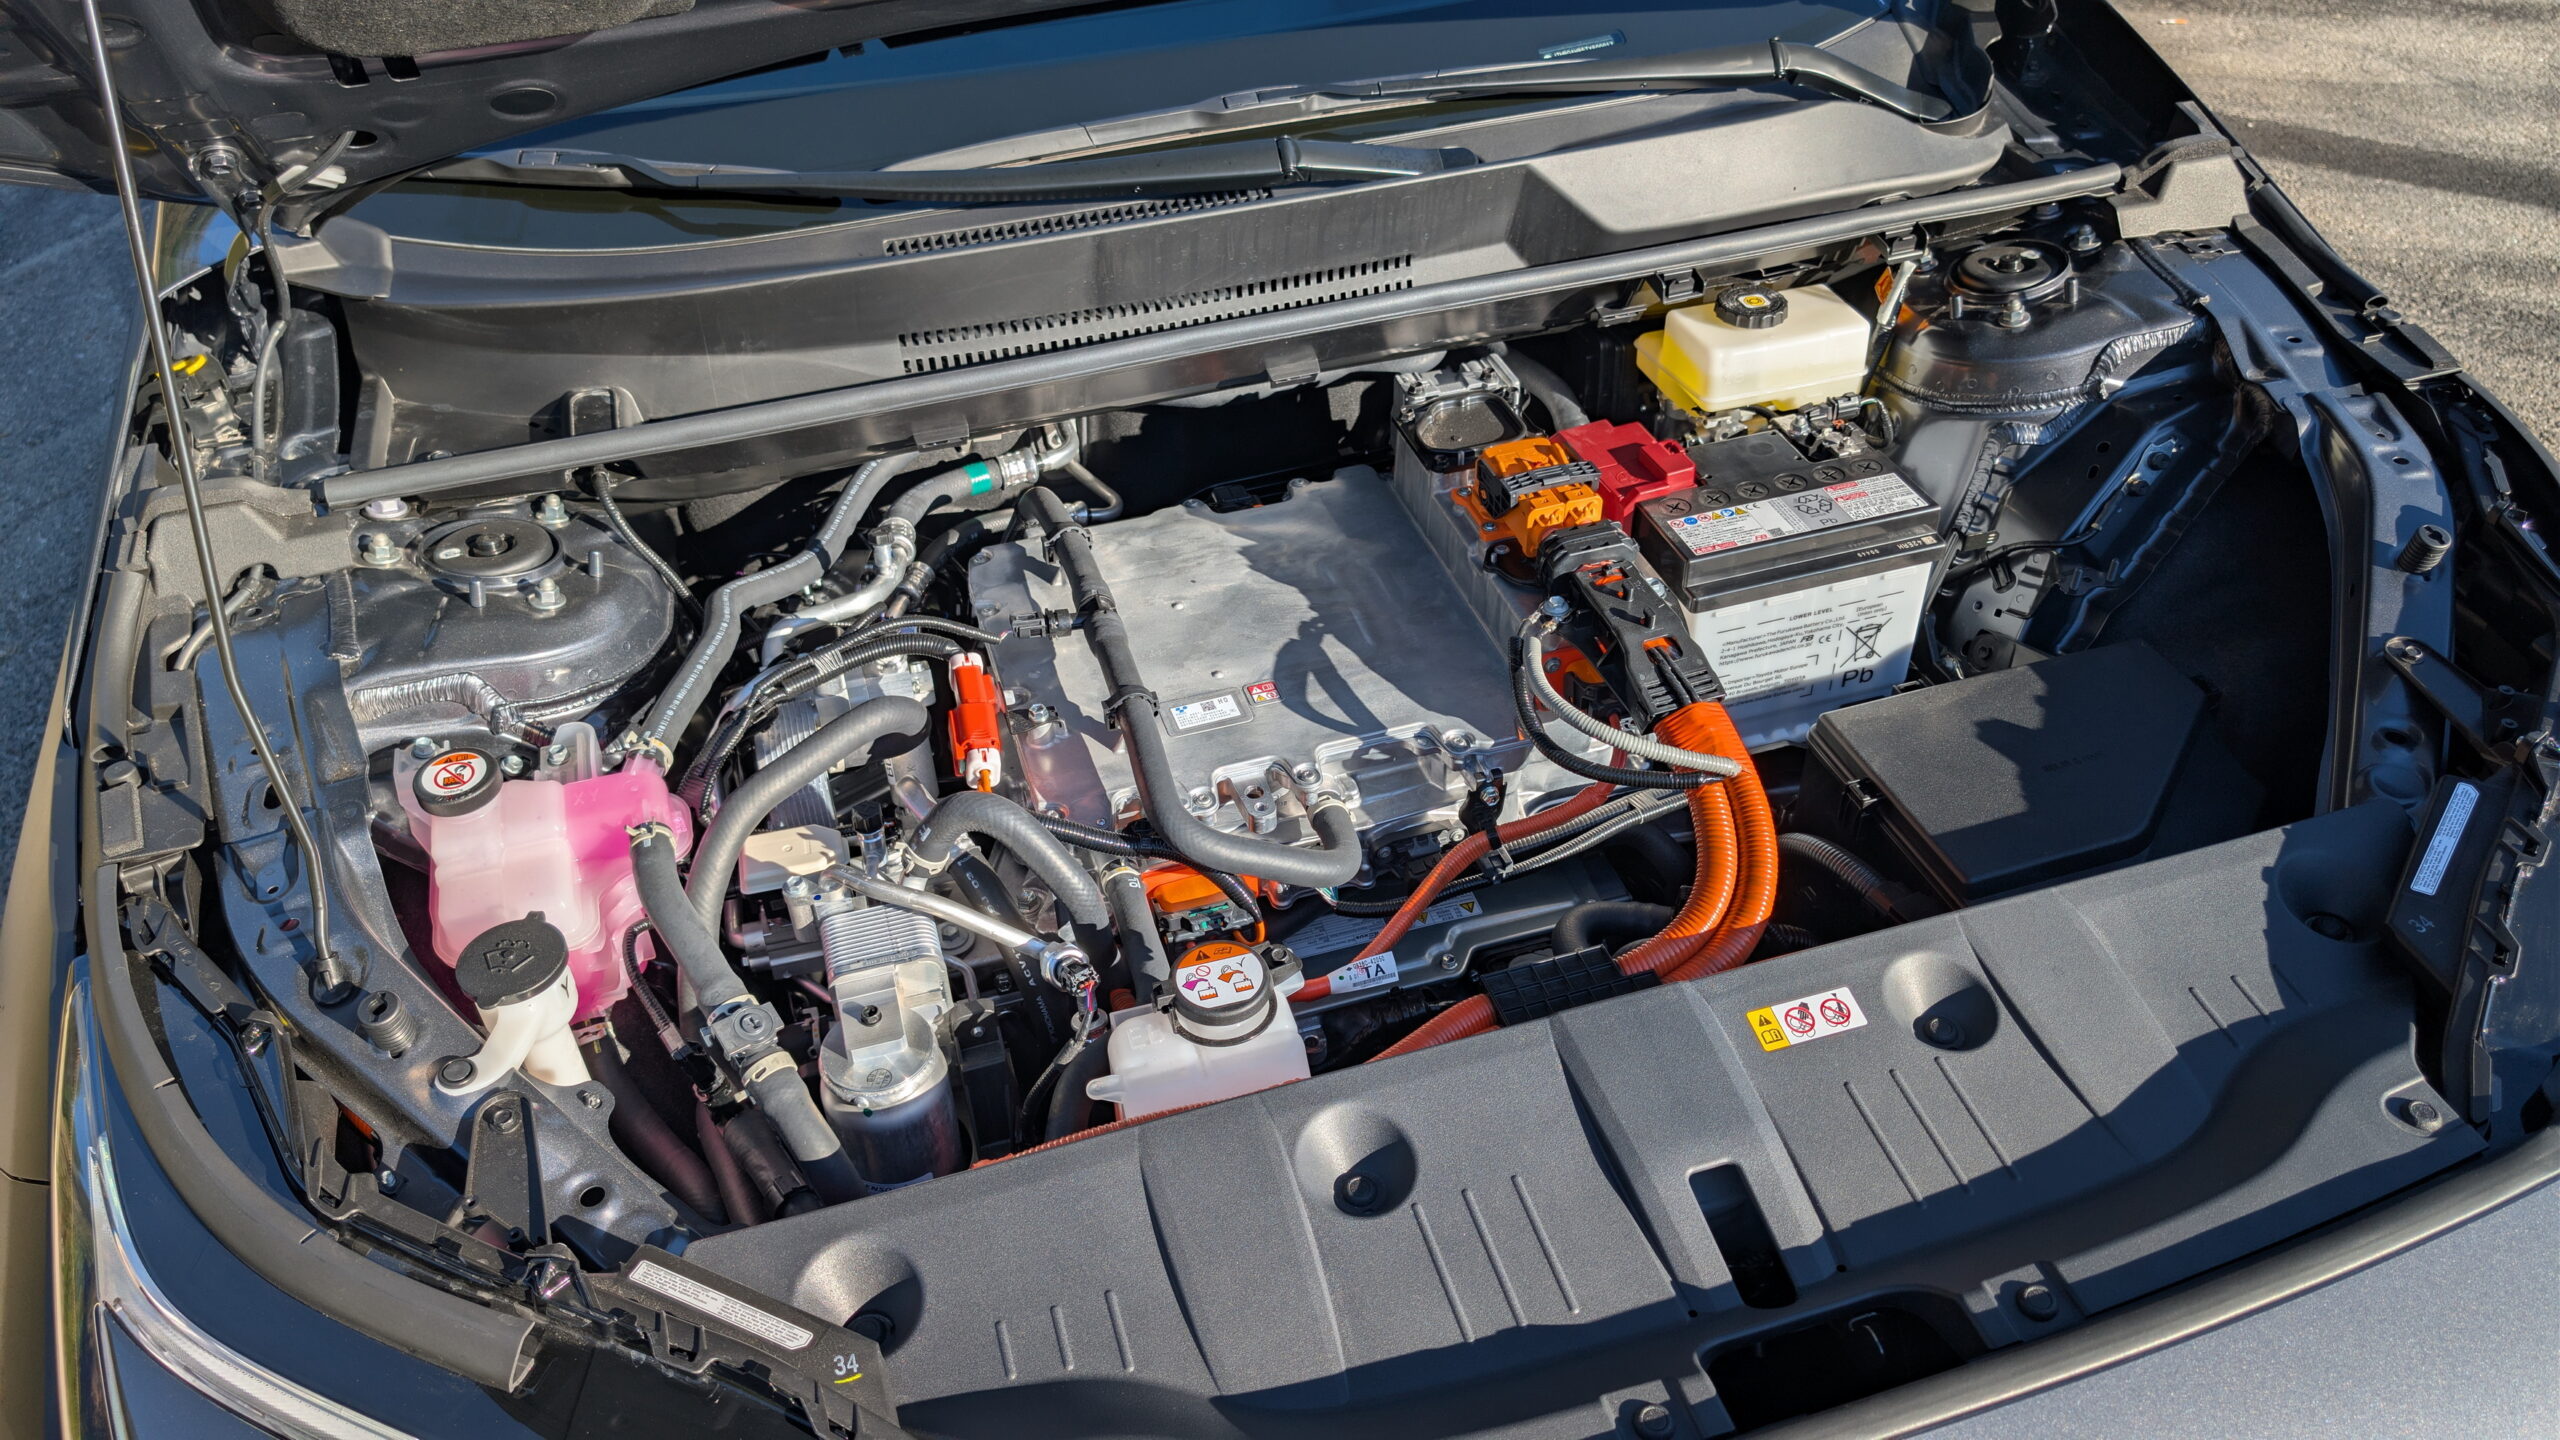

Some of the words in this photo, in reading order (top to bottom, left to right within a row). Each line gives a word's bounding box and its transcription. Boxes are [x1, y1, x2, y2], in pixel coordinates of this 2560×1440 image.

[1819, 517, 1838, 526] Pb
[1789, 611, 1812, 622] LOWER
[1813, 607, 1833, 616] LEVEL
[1719, 650, 1747, 660] Kanagawa
[1778, 638, 1796, 646] JAPAN
[1841, 667, 1874, 688] Pb
[2407, 914, 2435, 934] 34
[1363, 964, 1386, 978] TA
[833, 1353, 860, 1376] 34
